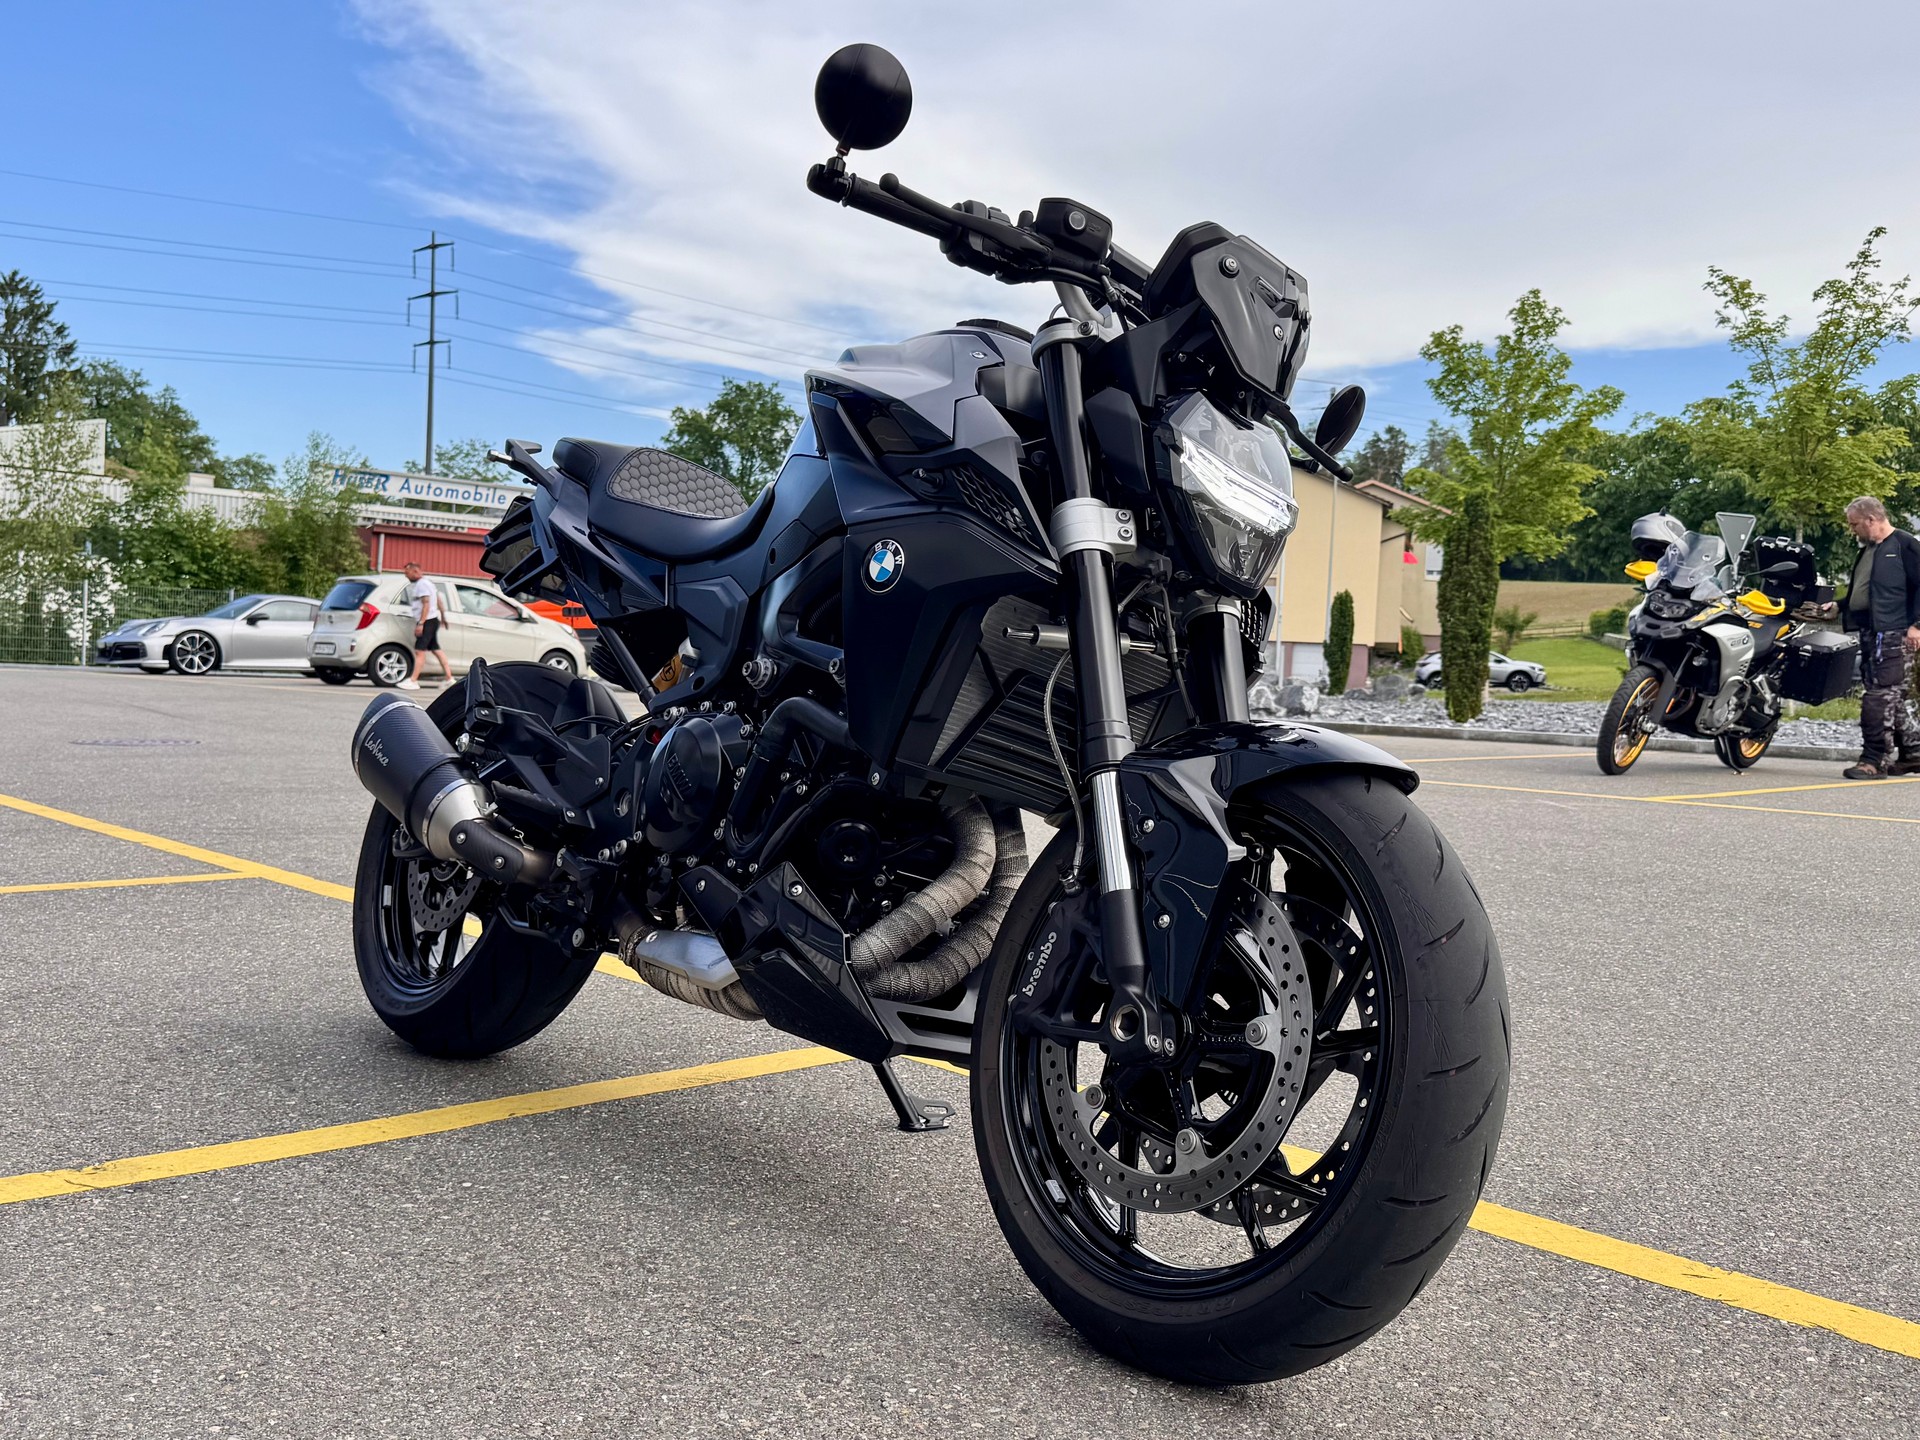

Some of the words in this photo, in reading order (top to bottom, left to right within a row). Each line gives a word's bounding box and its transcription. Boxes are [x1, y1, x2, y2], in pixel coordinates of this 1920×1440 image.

[400, 478, 507, 506] Automobile
[874, 541, 903, 565] BMW
[364, 731, 389, 767] LeoVince
[1021, 931, 1057, 997] brembo
